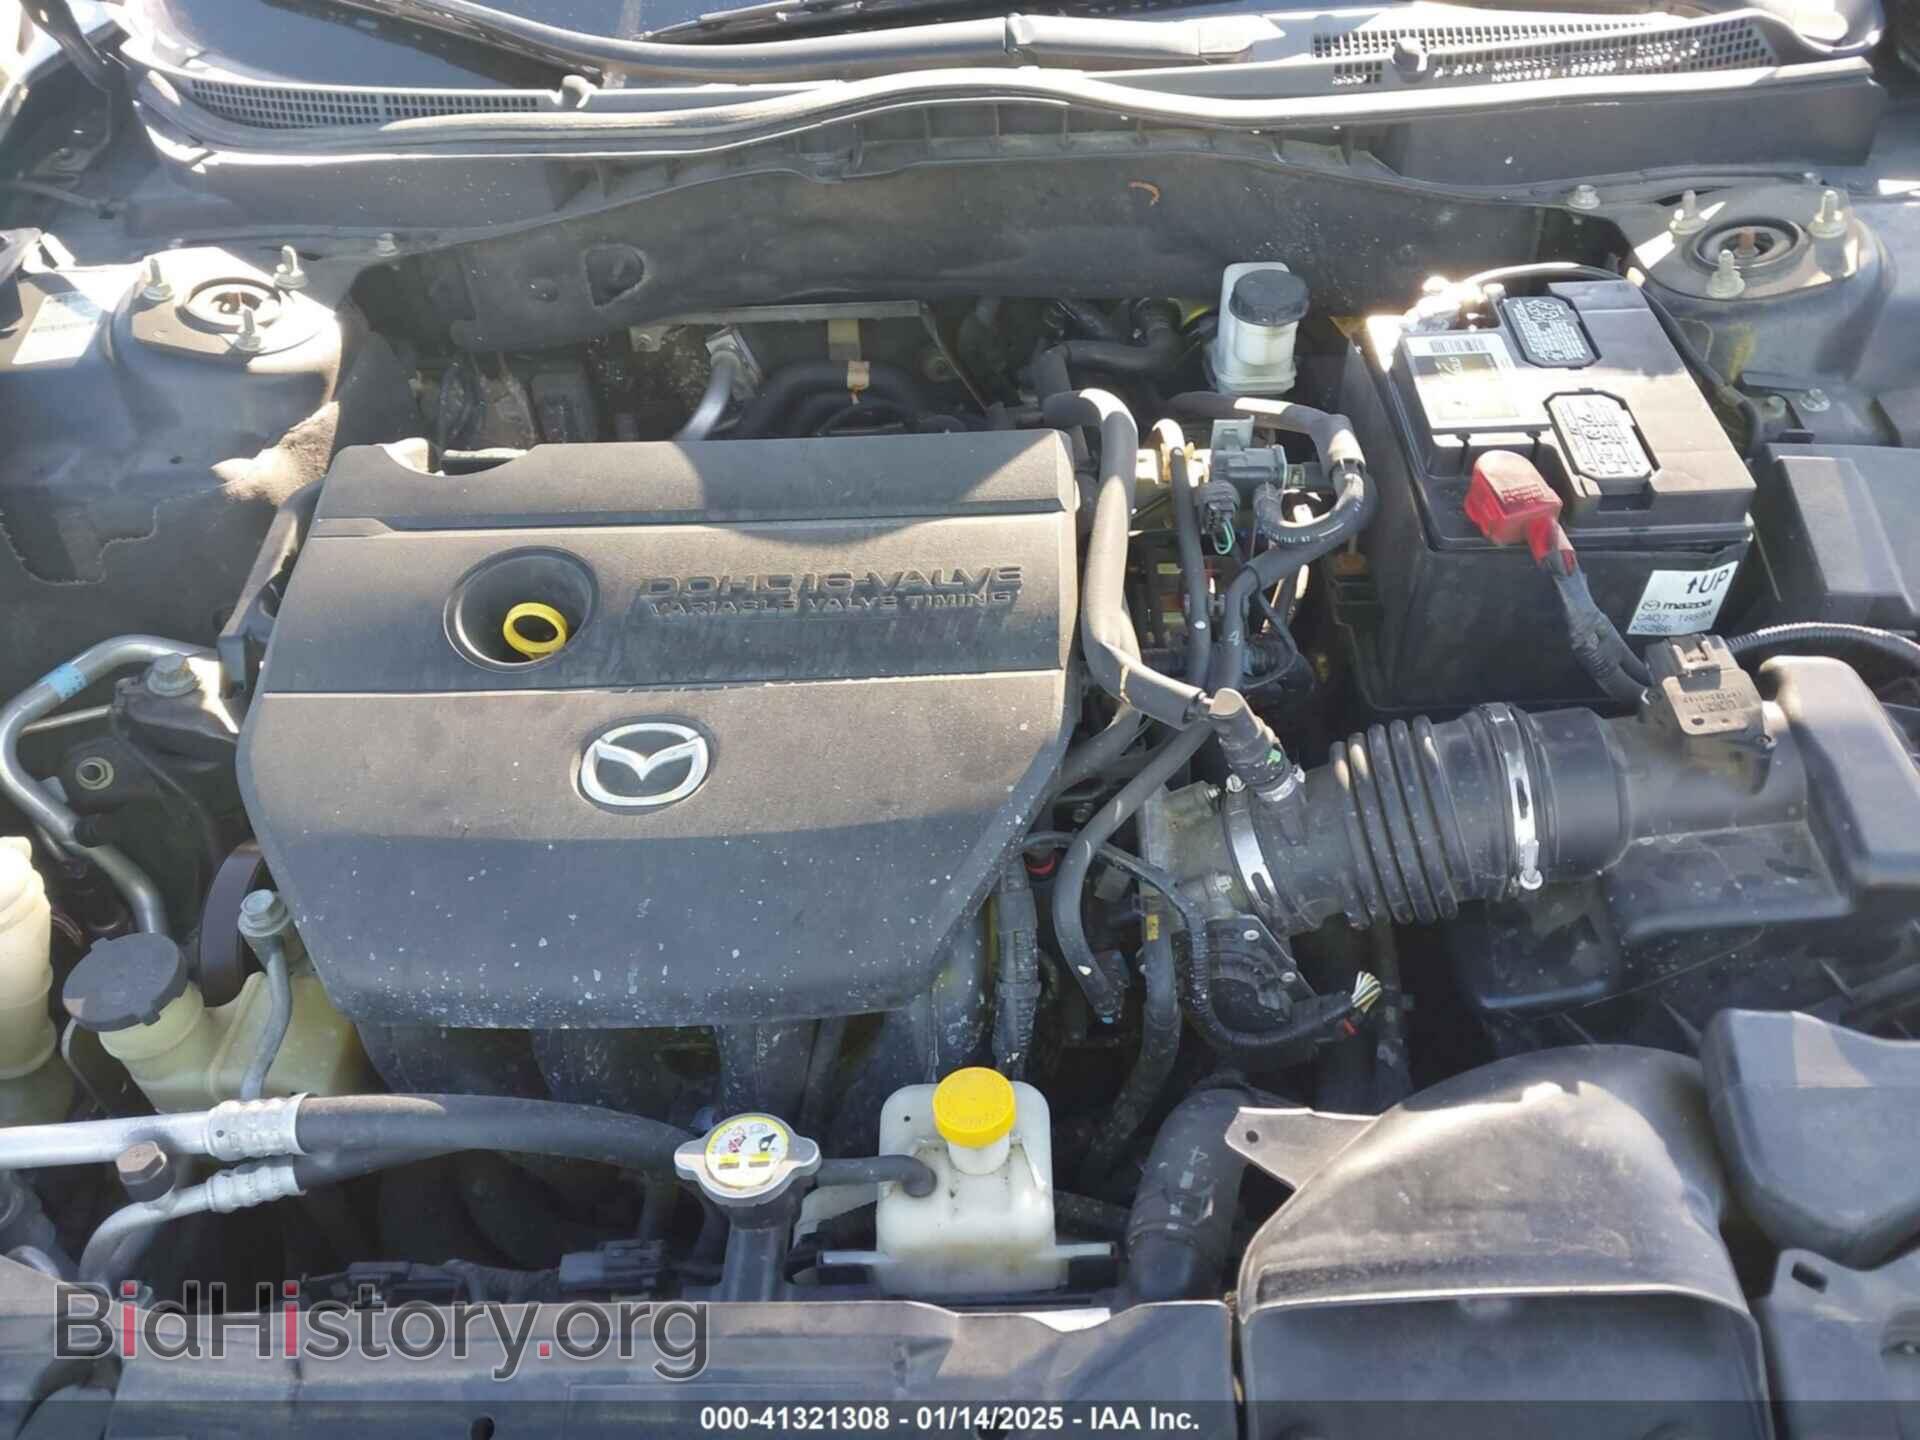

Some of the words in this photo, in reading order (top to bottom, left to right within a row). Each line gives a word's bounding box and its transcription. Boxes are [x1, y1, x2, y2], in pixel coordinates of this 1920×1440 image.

[1698, 568, 1730, 594] UP
[648, 597, 799, 617] VARIABLE
[805, 594, 898, 611] VALVE
[903, 590, 1012, 608] TIMING
